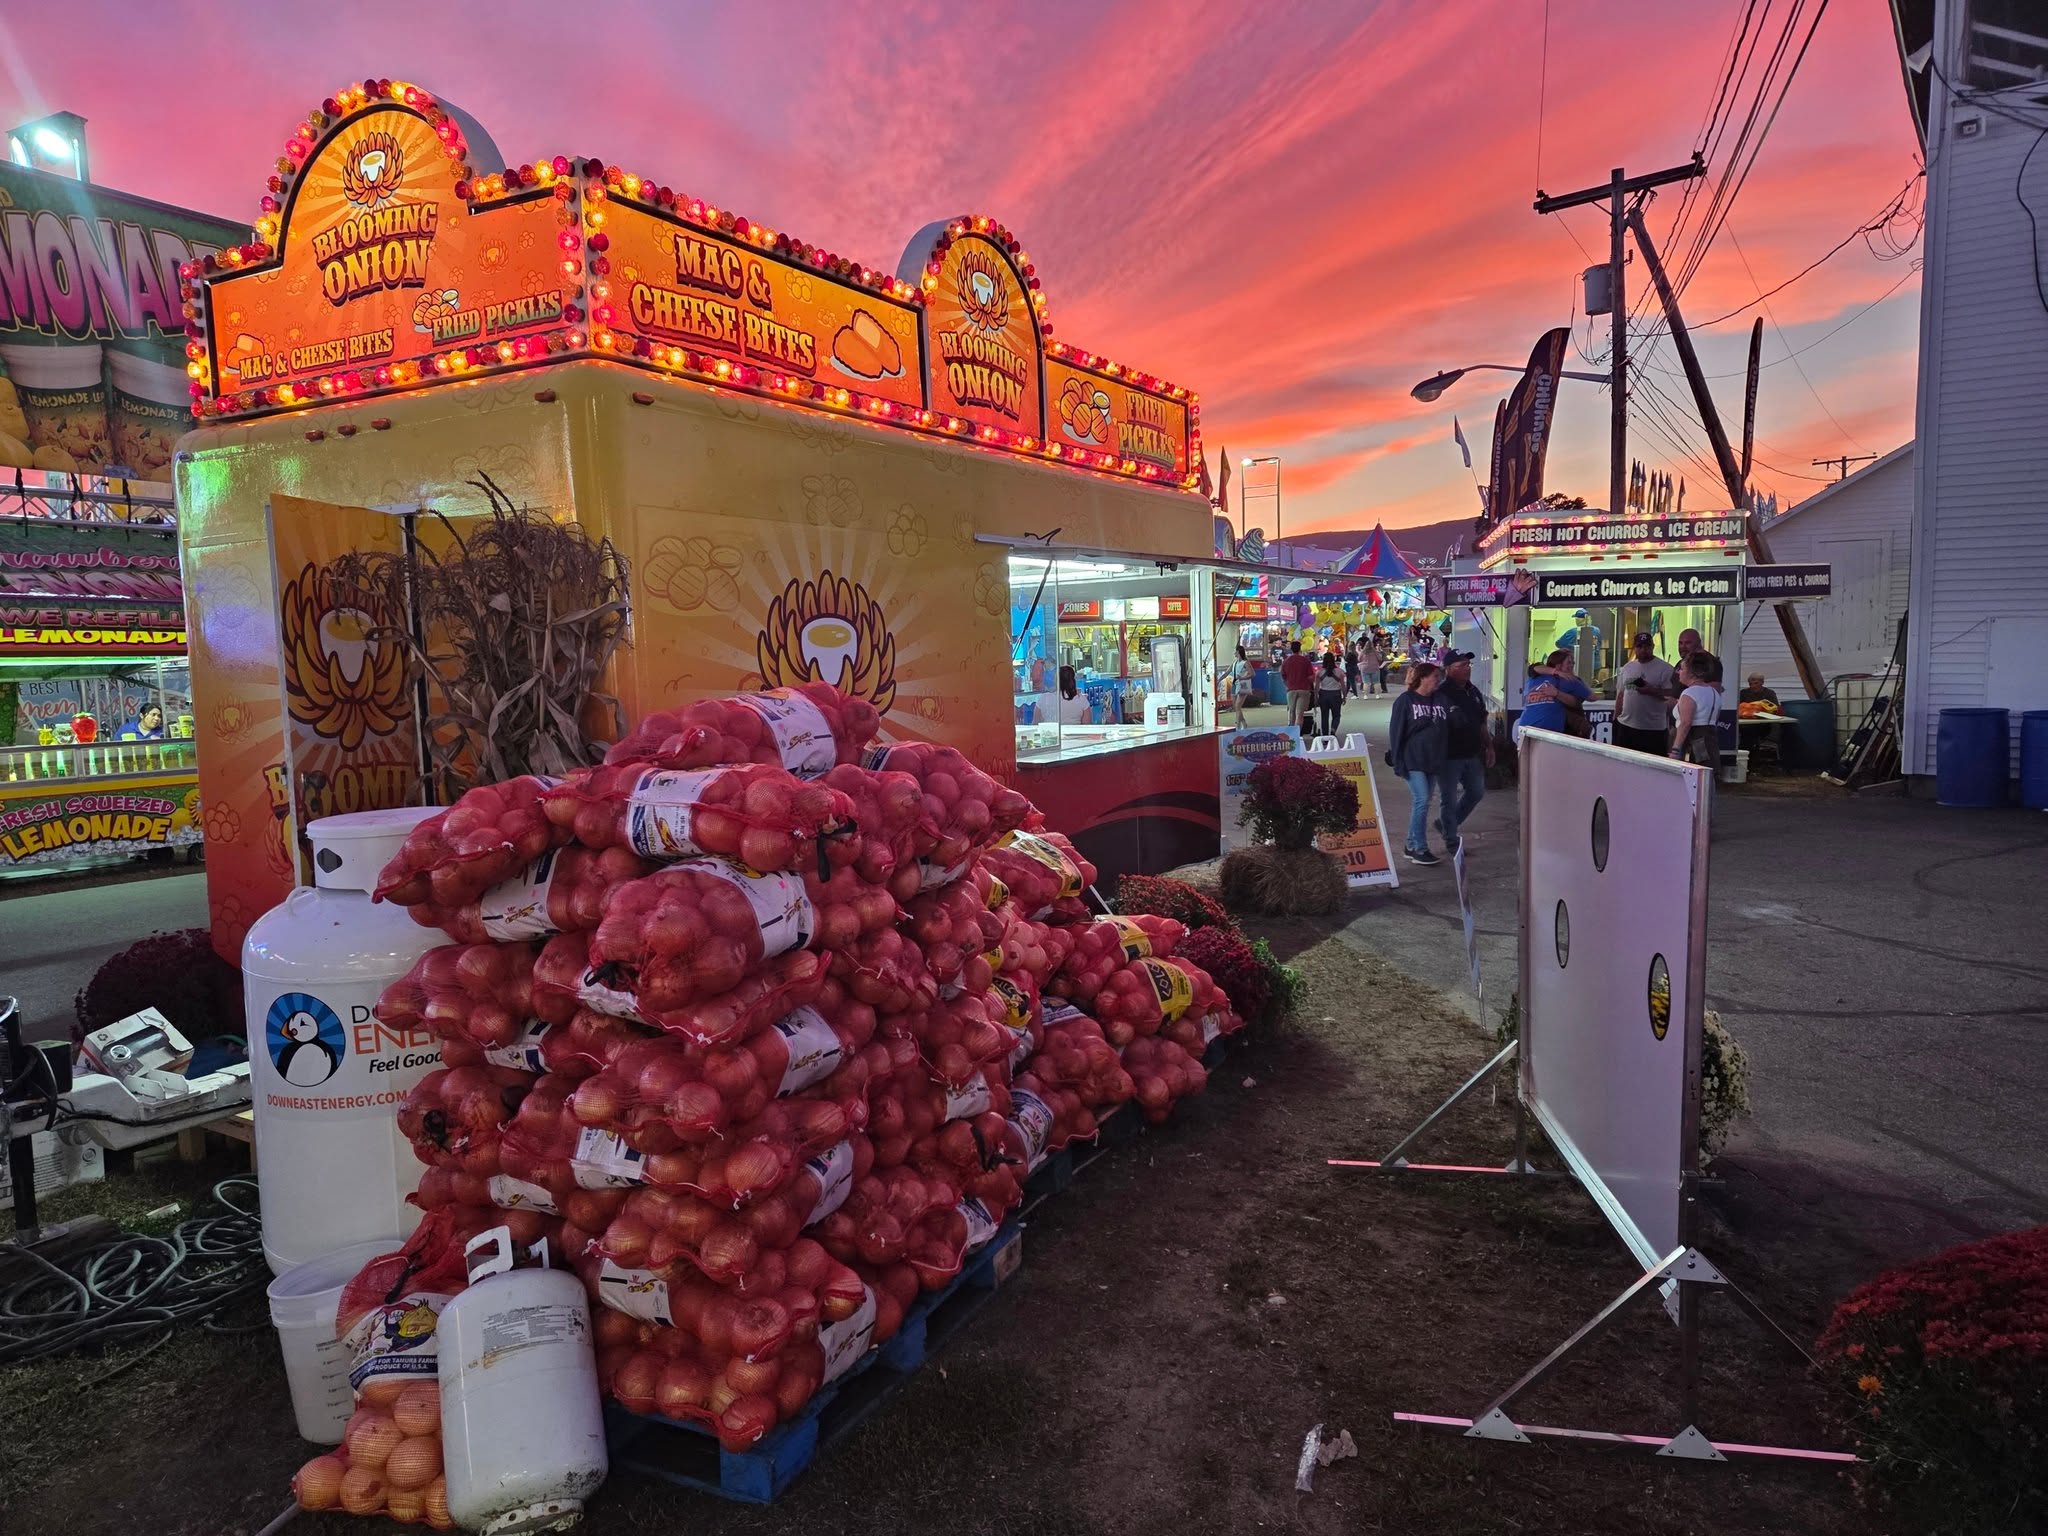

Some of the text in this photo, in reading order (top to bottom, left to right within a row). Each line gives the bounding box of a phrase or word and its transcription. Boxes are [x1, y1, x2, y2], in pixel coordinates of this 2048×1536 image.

[312, 203, 438, 263] BLOOMING
[0, 211, 222, 340] MONAD
[322, 239, 430, 304] ONION
[675, 235, 772, 310] MAC &
[433, 290, 562, 345] FRIED PICKLES
[630, 283, 816, 374] CHEESE BITES
[239, 329, 394, 381] MAC & CHEESE BITES
[940, 332, 1028, 383] BLOOMING
[27, 392, 89, 410] LEMONADE
[948, 362, 1023, 419] ONION
[121, 398, 179, 421] LEMONADE
[1125, 391, 1168, 428] FRIED
[1118, 421, 1176, 466] PICKLES
[1511, 520, 1742, 543] FRESH HOT CHURROS & ICE CREAM
[1448, 577, 1508, 591] FRESH FRIED PIES
[1546, 576, 1730, 598] Gourmet Churros & Ice Cream
[1747, 576, 1766, 588] FRESH
[1767, 575, 1783, 587] FRIED
[1784, 574, 1797, 586] PIES
[1804, 573, 1830, 586] CHURROS
[1064, 602, 1090, 613] CONES
[1167, 601, 1183, 611] COFFEE
[1464, 591, 1496, 603] CHURROS
[0, 607, 185, 628] WE REFILL
[0, 628, 187, 644] LEMONAD
[30, 681, 61, 696] BEST
[1589, 711, 1612, 723] HOT
[66, 795, 177, 816] SQUEEZED
[1, 814, 172, 860] LEMONADE
[369, 1056, 399, 1074] Feel
[267, 1089, 408, 1111] DOWNEASTENERGY.COM
